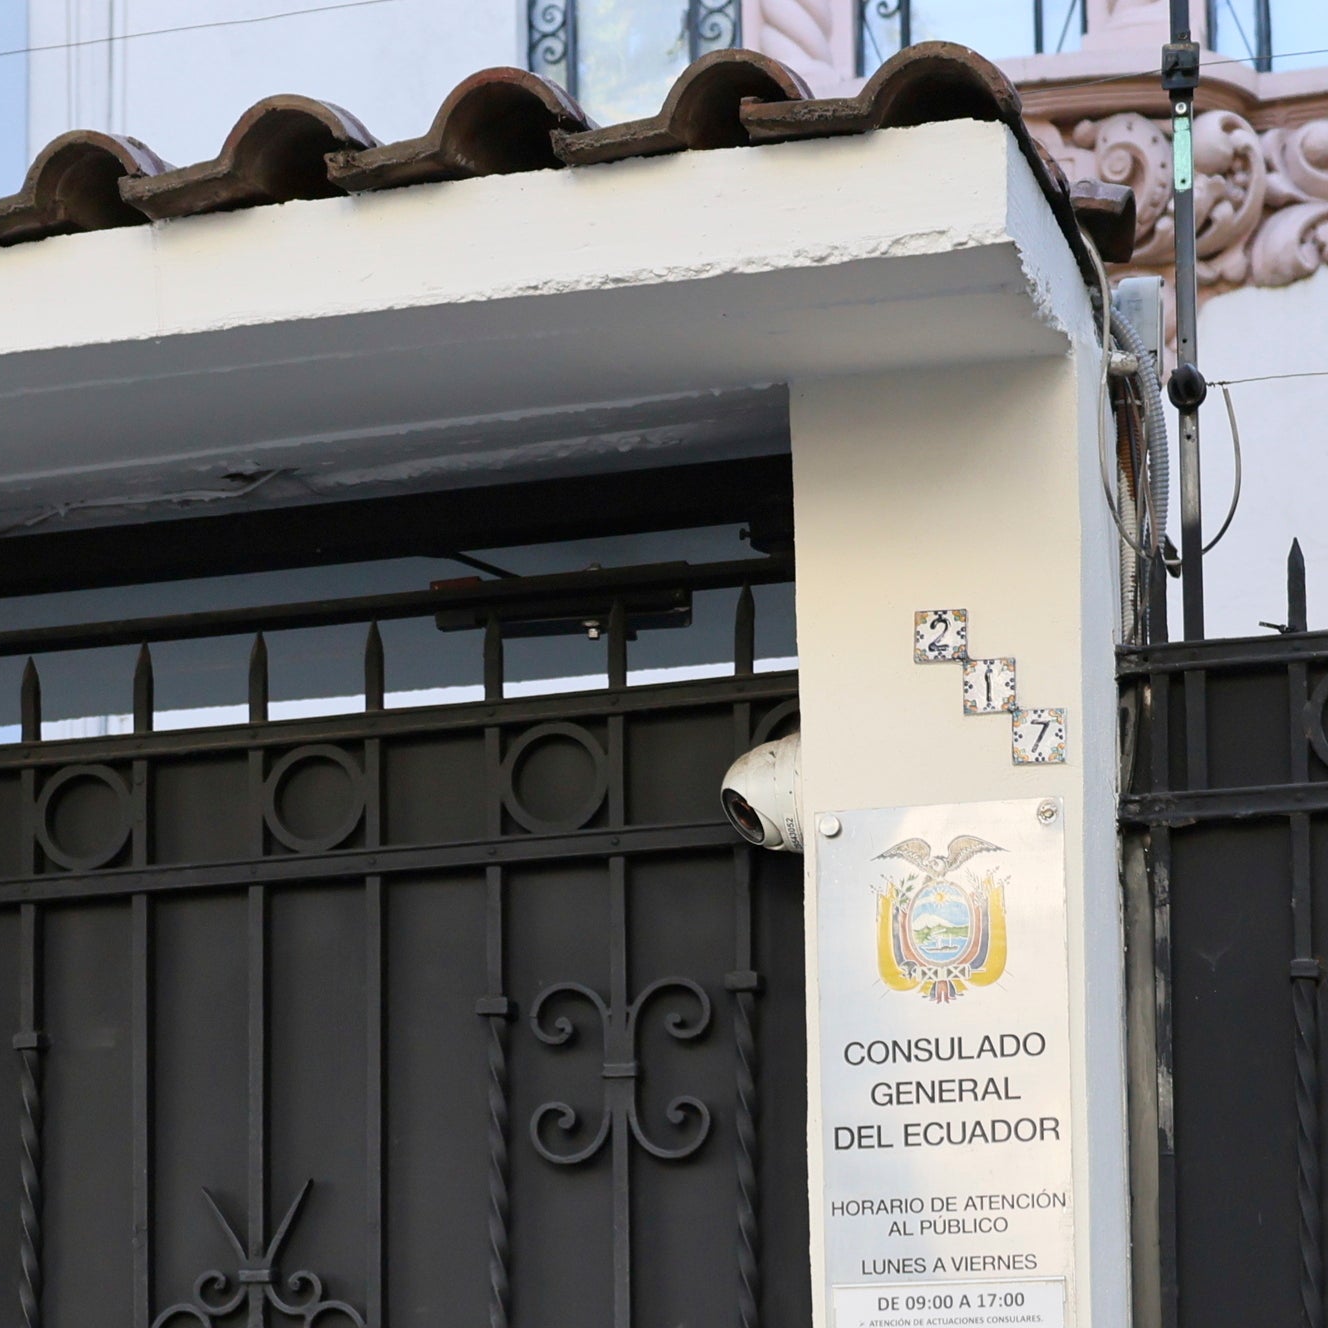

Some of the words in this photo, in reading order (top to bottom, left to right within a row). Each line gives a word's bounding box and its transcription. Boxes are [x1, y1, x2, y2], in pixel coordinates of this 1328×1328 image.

[843, 1031, 1046, 1066] CONSULADO
[870, 1076, 1021, 1107] GENERAL
[833, 1124, 894, 1151] DEL
[903, 1116, 1061, 1148] ECUADOR
[831, 1196, 925, 1217] HORARIO
[930, 1195, 958, 1213] DE
[963, 1188, 1066, 1212] ATENCIÓN
[887, 1220, 914, 1238] AL
[920, 1214, 1009, 1236] PÚBLICO
[861, 1256, 927, 1276] LUNES
[932, 1256, 947, 1274] A
[950, 1253, 1038, 1273] VIERNES
[877, 1295, 901, 1312] DE
[905, 1294, 954, 1311] 09:00
[958, 1293, 972, 1309] A
[976, 1291, 1025, 1308] 17:00
[869, 1317, 911, 1328] ATENCIÓN
[912, 1317, 924, 1327] DE
[926, 1316, 985, 1326] ACTUACIONES
